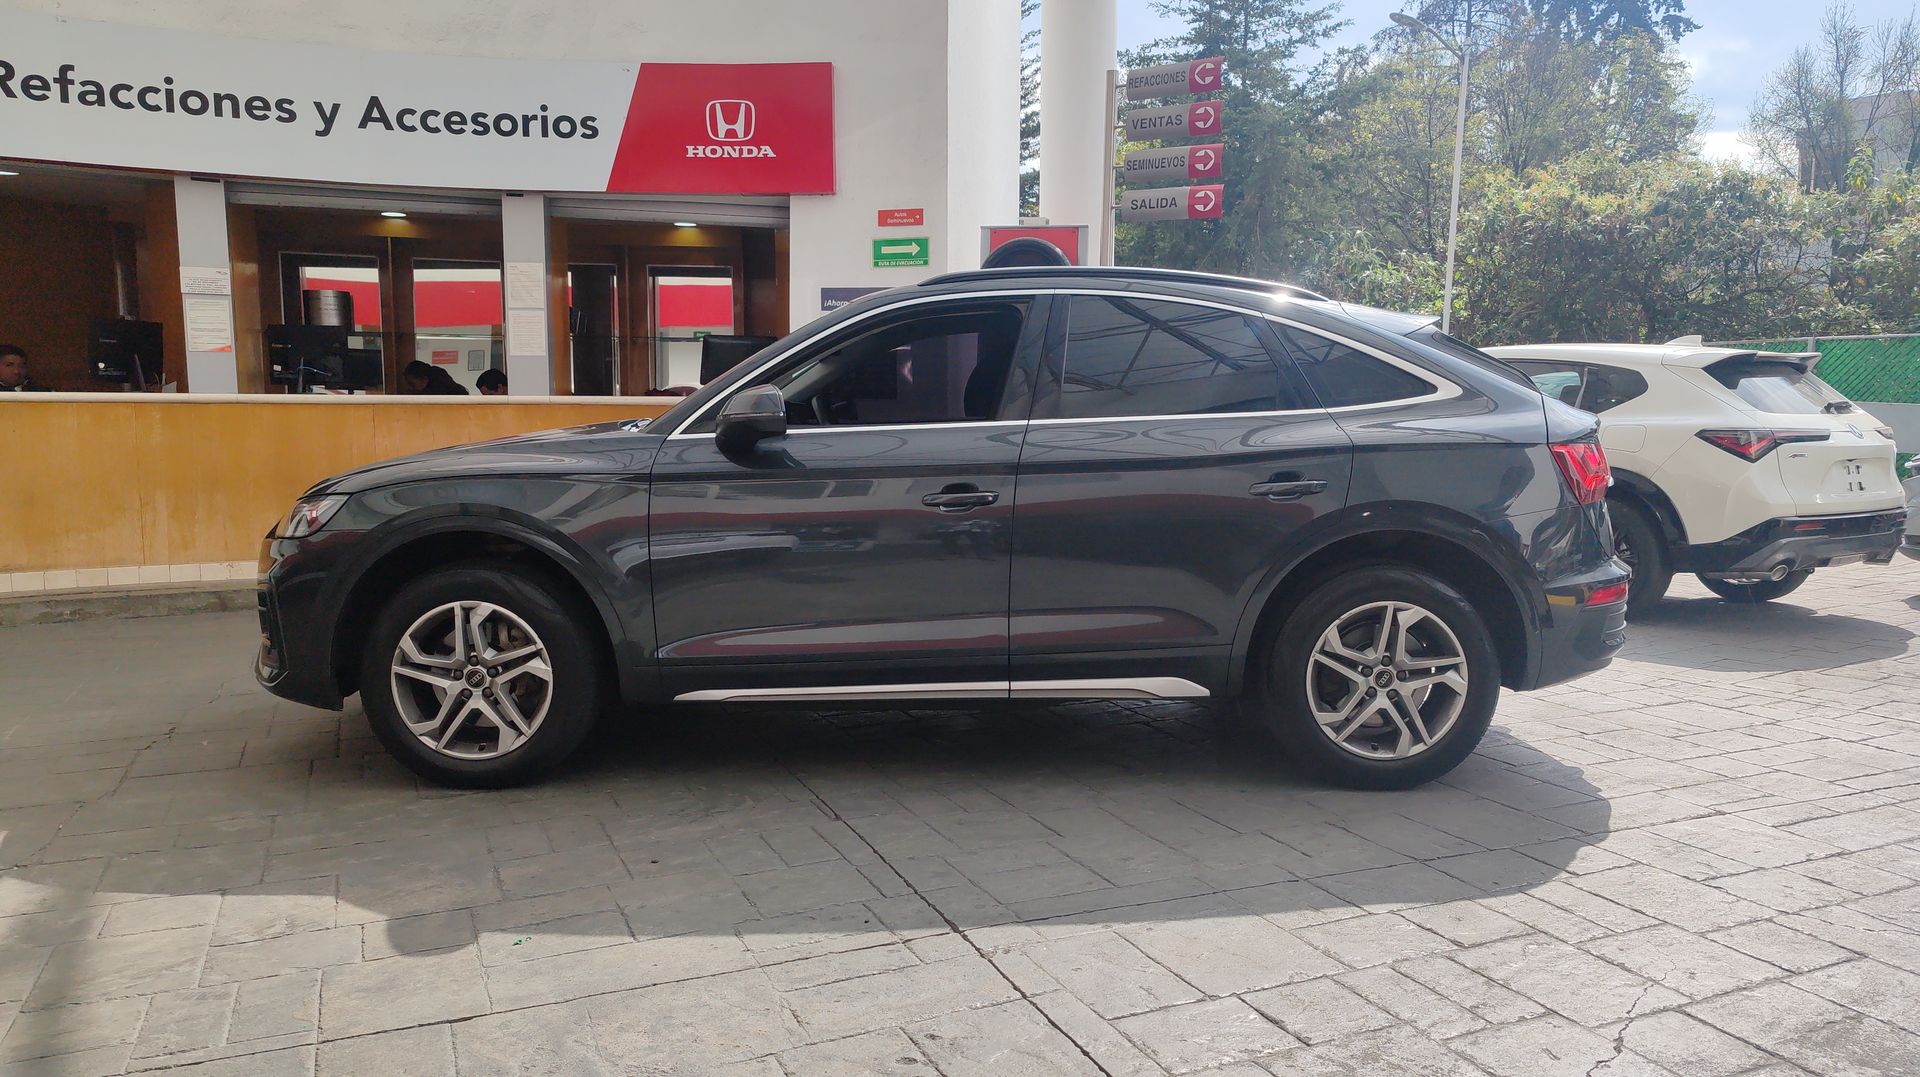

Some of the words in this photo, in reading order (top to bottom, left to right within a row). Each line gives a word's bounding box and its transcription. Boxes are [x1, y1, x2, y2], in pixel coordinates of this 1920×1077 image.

[1128, 72, 1186, 89] REFACCIONES
[0, 59, 298, 123] Refacciones
[313, 101, 341, 137] y
[358, 95, 600, 140] Accesorios
[1132, 115, 1183, 130] VENTAS
[685, 145, 777, 158] HONDA
[1126, 155, 1186, 171] SEMINUEVOS
[1130, 197, 1178, 211] SALIDA
